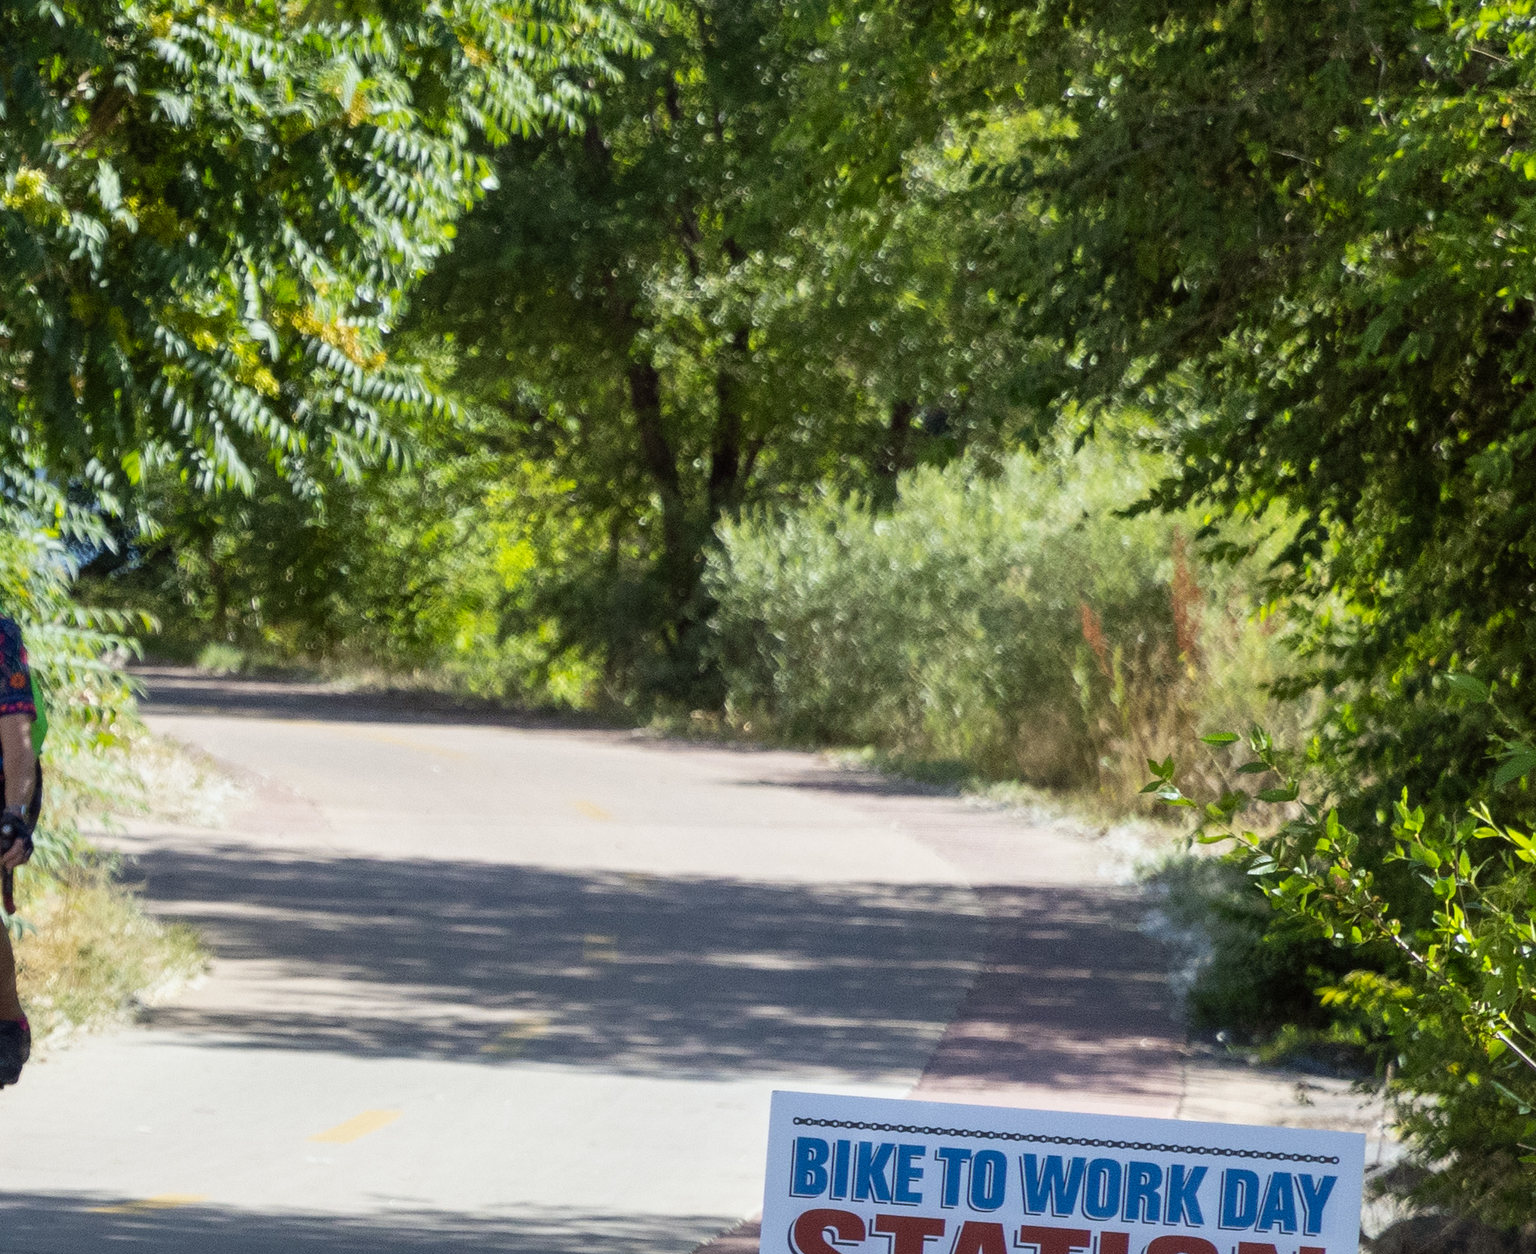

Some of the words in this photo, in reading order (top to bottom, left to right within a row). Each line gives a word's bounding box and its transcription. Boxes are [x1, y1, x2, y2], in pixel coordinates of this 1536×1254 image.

[789, 1136, 926, 1207] BIKE
[935, 1146, 1008, 1212] TO
[1019, 1153, 1209, 1228] WORK
[1218, 1168, 1338, 1237] DAY
